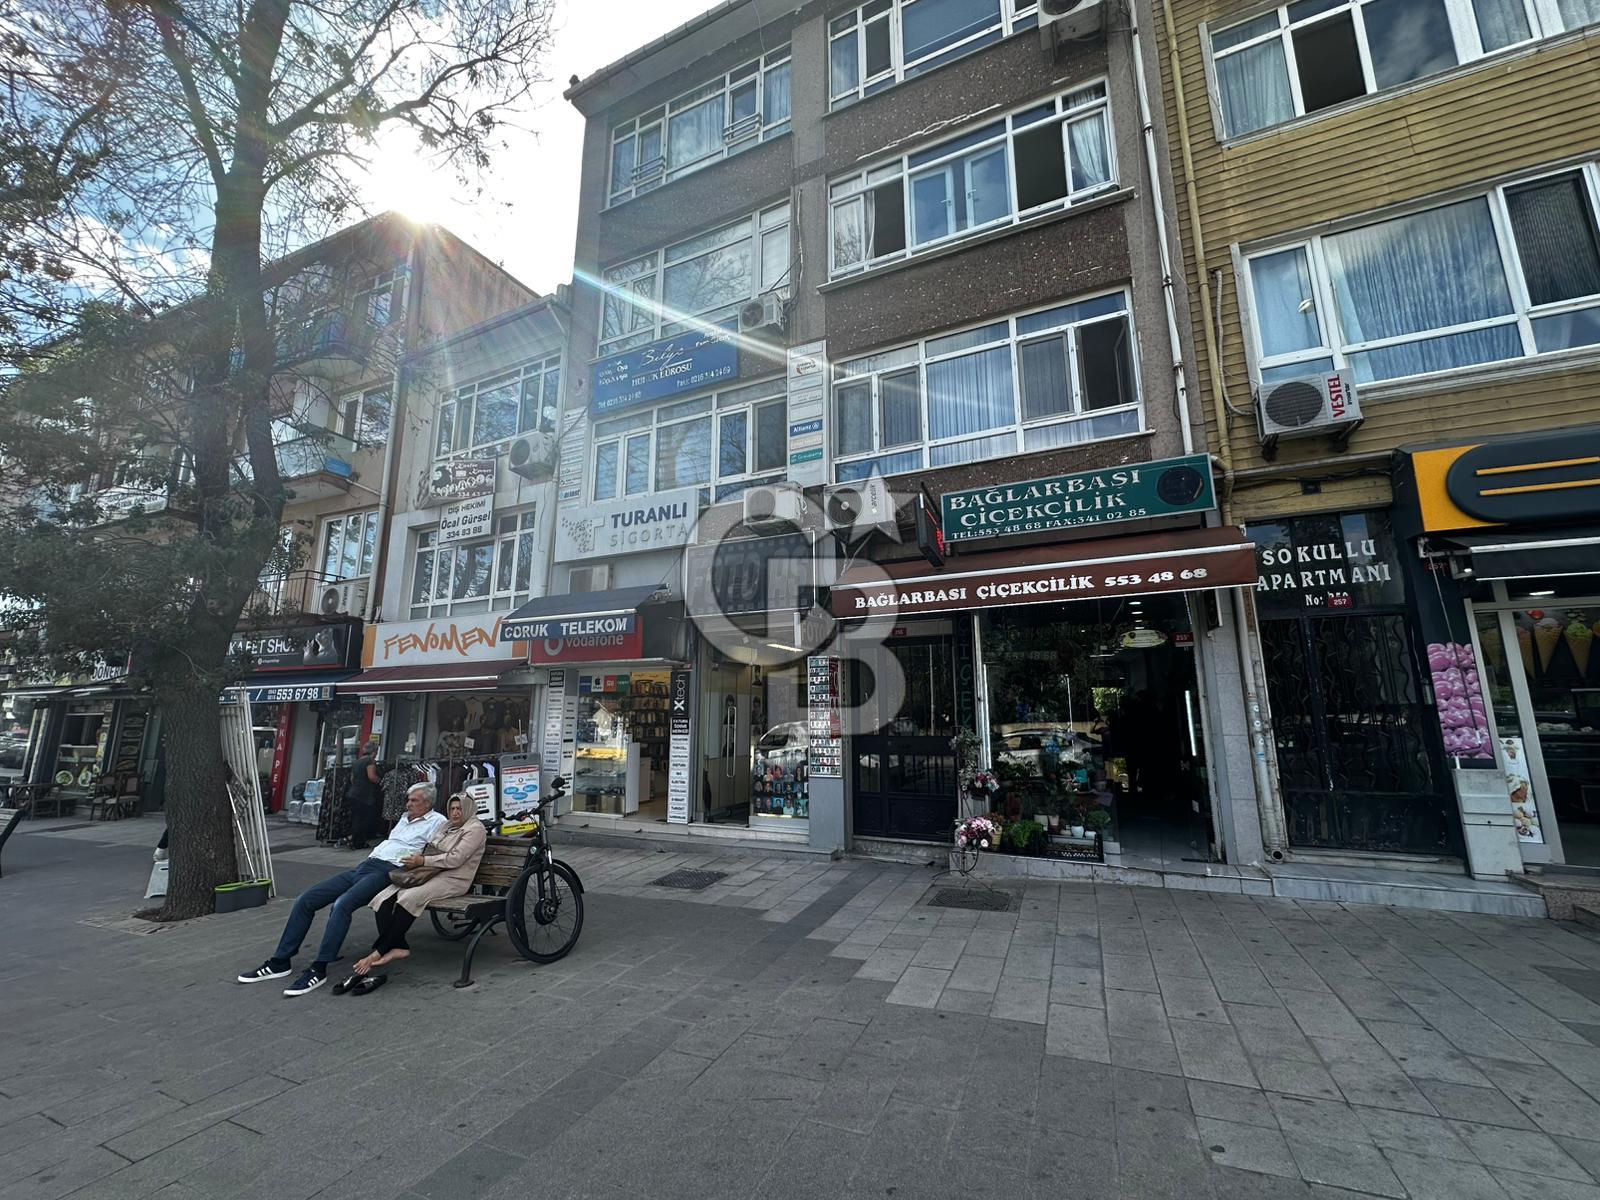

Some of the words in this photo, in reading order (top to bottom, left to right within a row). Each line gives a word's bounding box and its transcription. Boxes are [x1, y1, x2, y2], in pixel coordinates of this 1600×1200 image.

[1327, 374, 1346, 418] VESTEL
[441, 517, 460, 529] Öcal
[462, 510, 491, 526] Gürsel
[611, 502, 688, 528] TURANLI
[1004, 525, 1020, 533] 48
[1025, 522, 1042, 530] 68
[1106, 511, 1123, 520] 02
[1129, 508, 1146, 517] 85
[1262, 539, 1377, 566] SOKULLU
[1104, 574, 1141, 587] 553
[1147, 570, 1175, 583] 48
[1179, 568, 1208, 580] 68
[1256, 564, 1391, 591] APARTMANI
[1305, 594, 1323, 606] No:
[384, 616, 503, 660] FENOMEN
[560, 617, 628, 636] TELEKOM
[276, 688, 294, 700] 553
